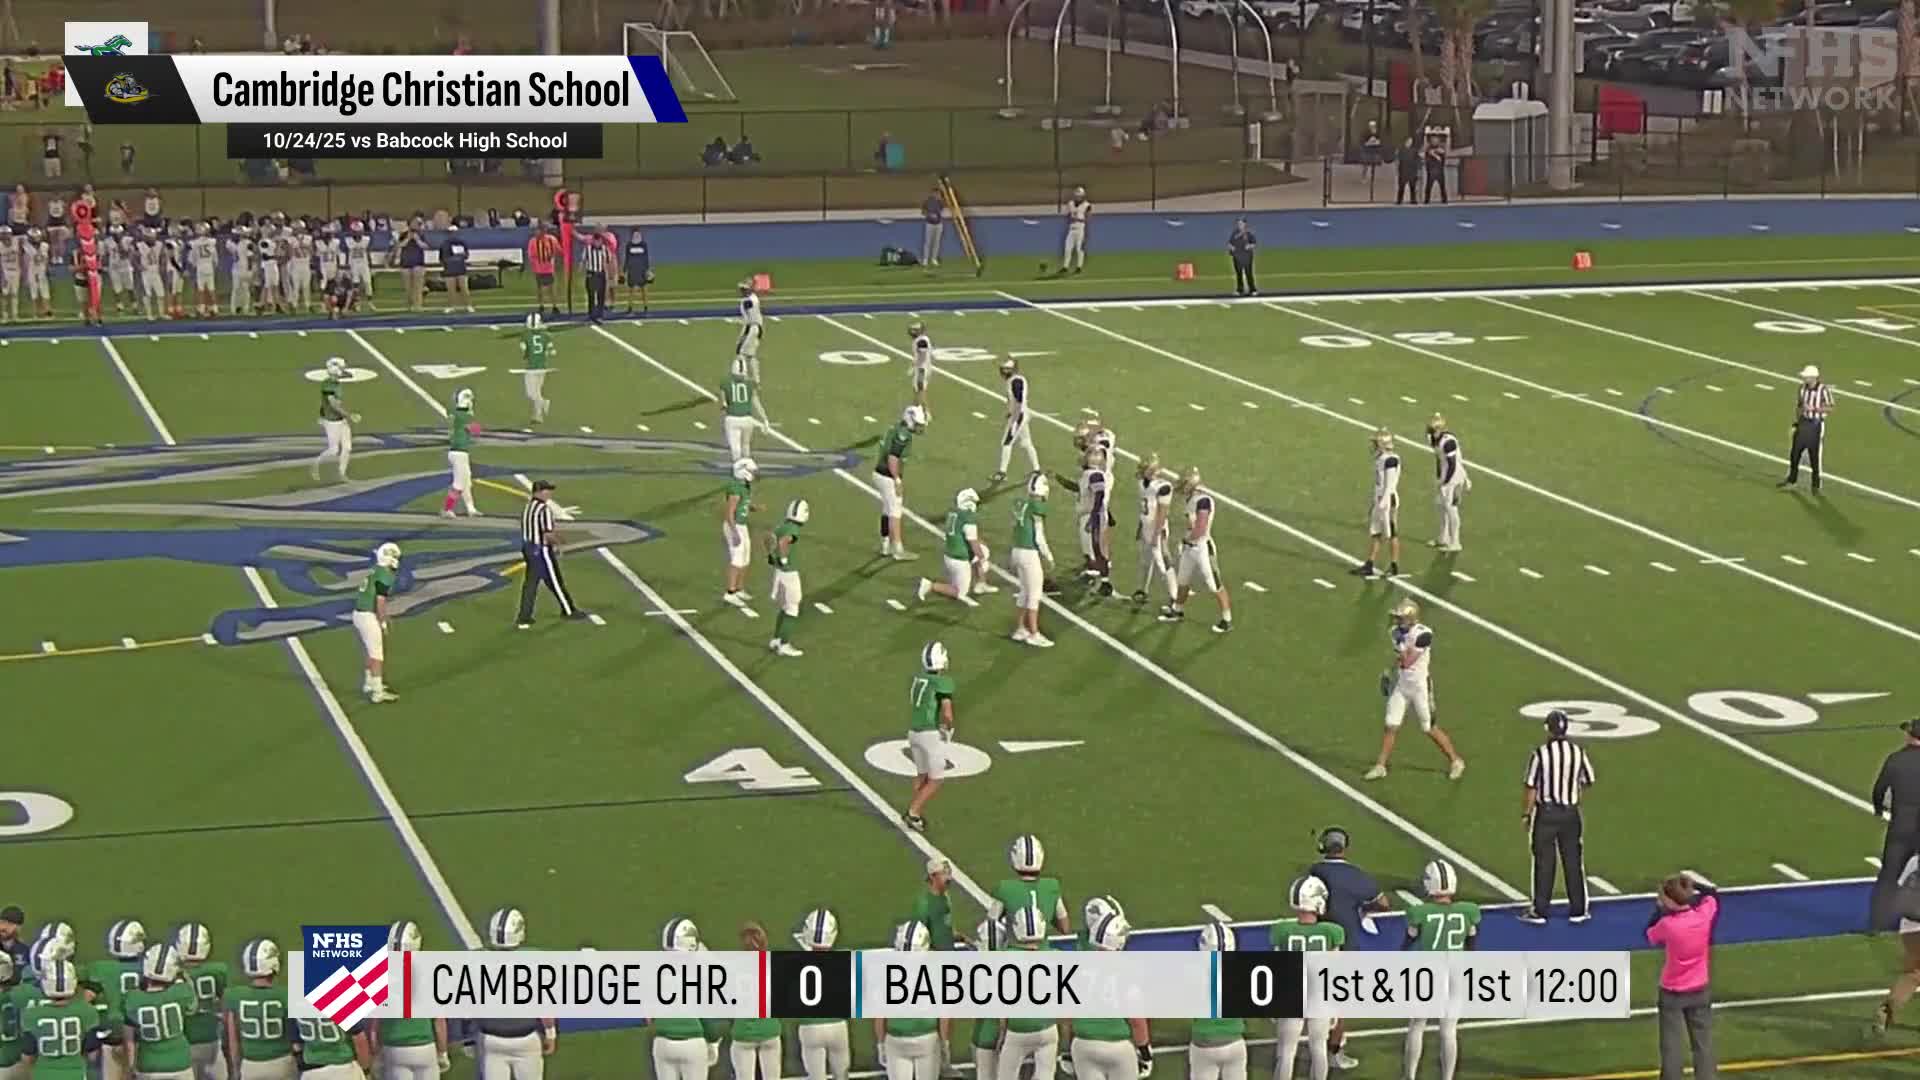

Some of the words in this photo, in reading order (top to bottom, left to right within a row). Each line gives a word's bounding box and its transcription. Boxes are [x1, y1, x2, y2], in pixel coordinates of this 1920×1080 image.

[532, 335, 543, 354] 5
[731, 383, 748, 402] 10
[911, 676, 929, 708] 17
[1427, 913, 1465, 950] 72
[38, 1016, 81, 1056] 28
[138, 1003, 183, 1041] 80
[240, 1000, 283, 1039] 56
